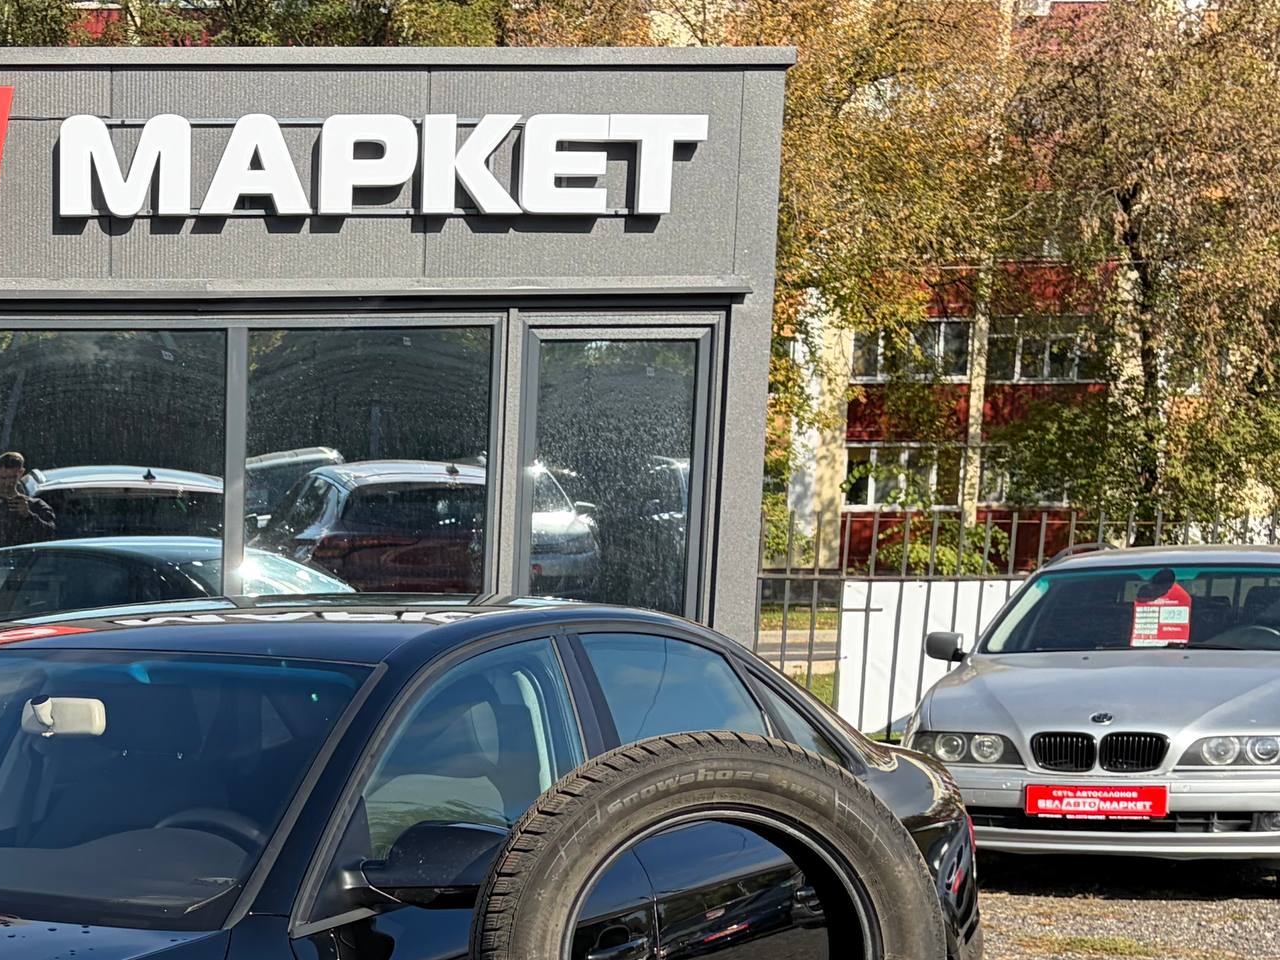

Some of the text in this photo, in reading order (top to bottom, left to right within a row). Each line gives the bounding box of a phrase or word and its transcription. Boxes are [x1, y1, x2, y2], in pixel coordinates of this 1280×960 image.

[59, 113, 709, 217] МАРКЕТ
[1065, 800, 1096, 808] АВТО
[1099, 801, 1152, 810] МАРКЕТ
